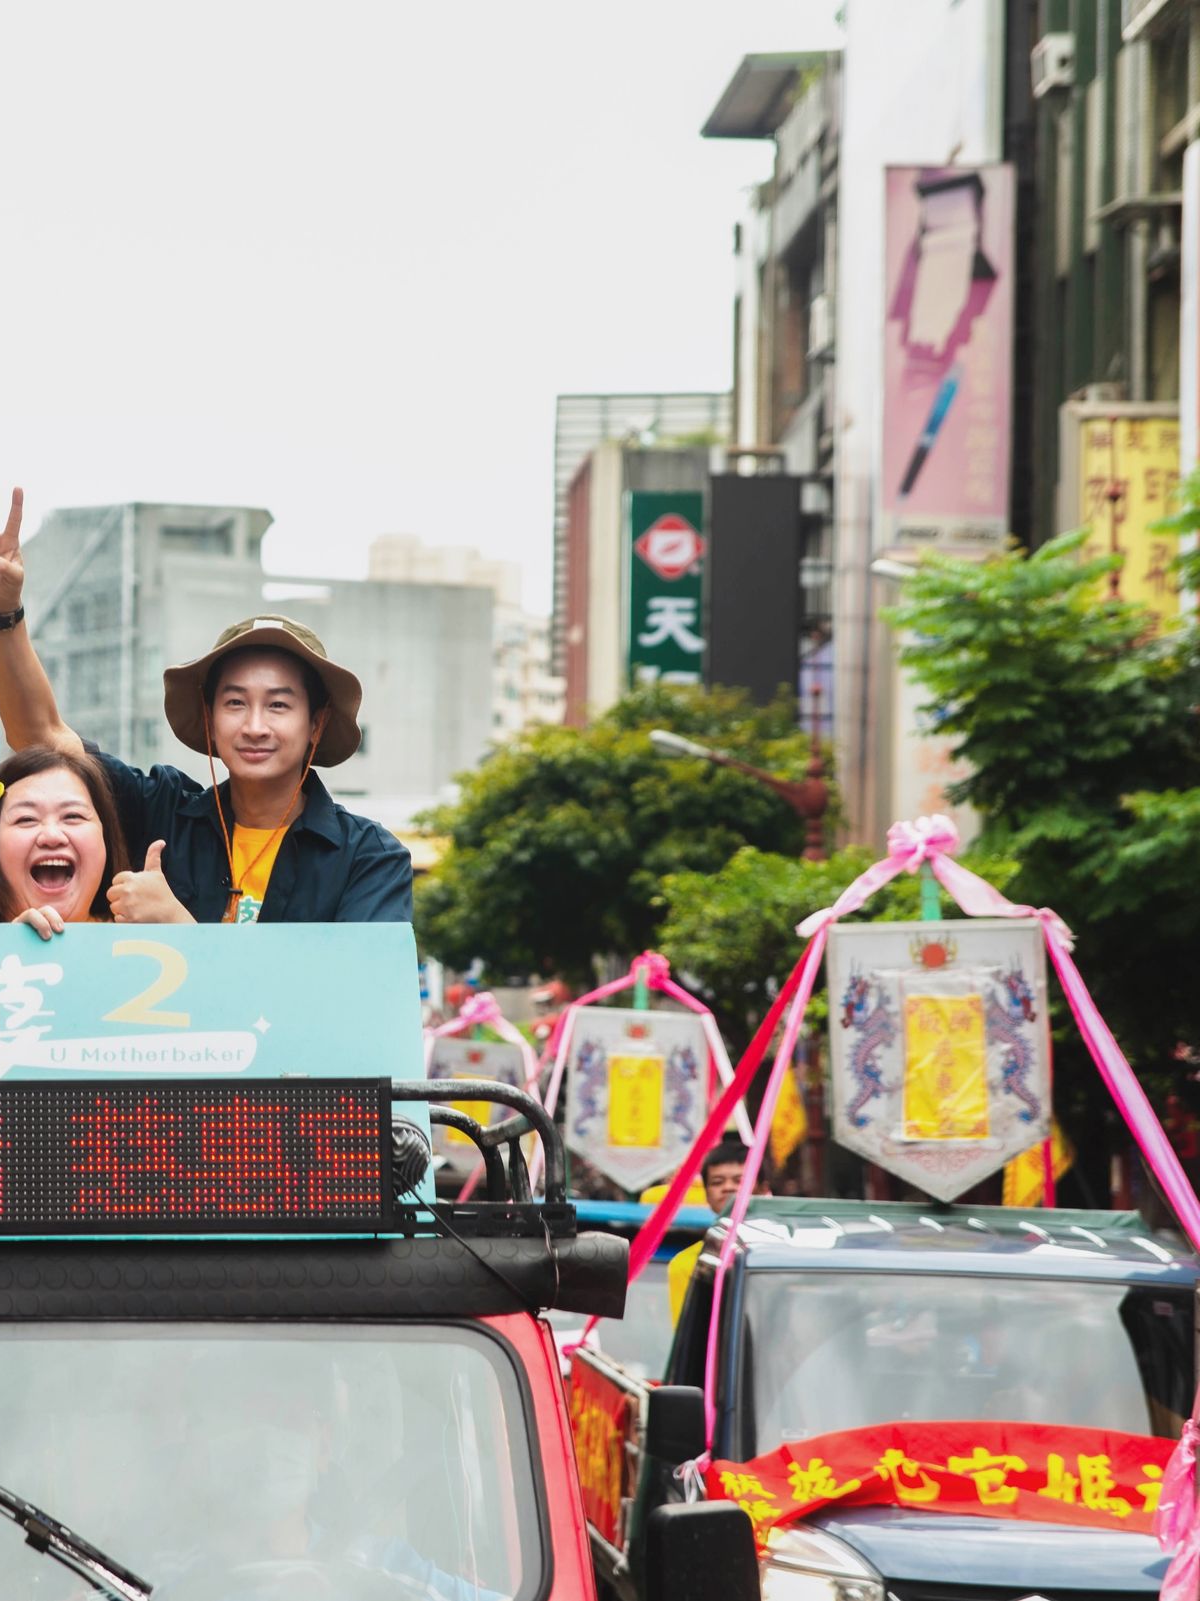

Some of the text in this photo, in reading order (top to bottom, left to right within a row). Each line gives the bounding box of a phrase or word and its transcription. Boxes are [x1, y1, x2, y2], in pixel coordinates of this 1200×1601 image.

[100, 938, 192, 1029] 2
[49, 1046, 246, 1064] U Motherbaker
